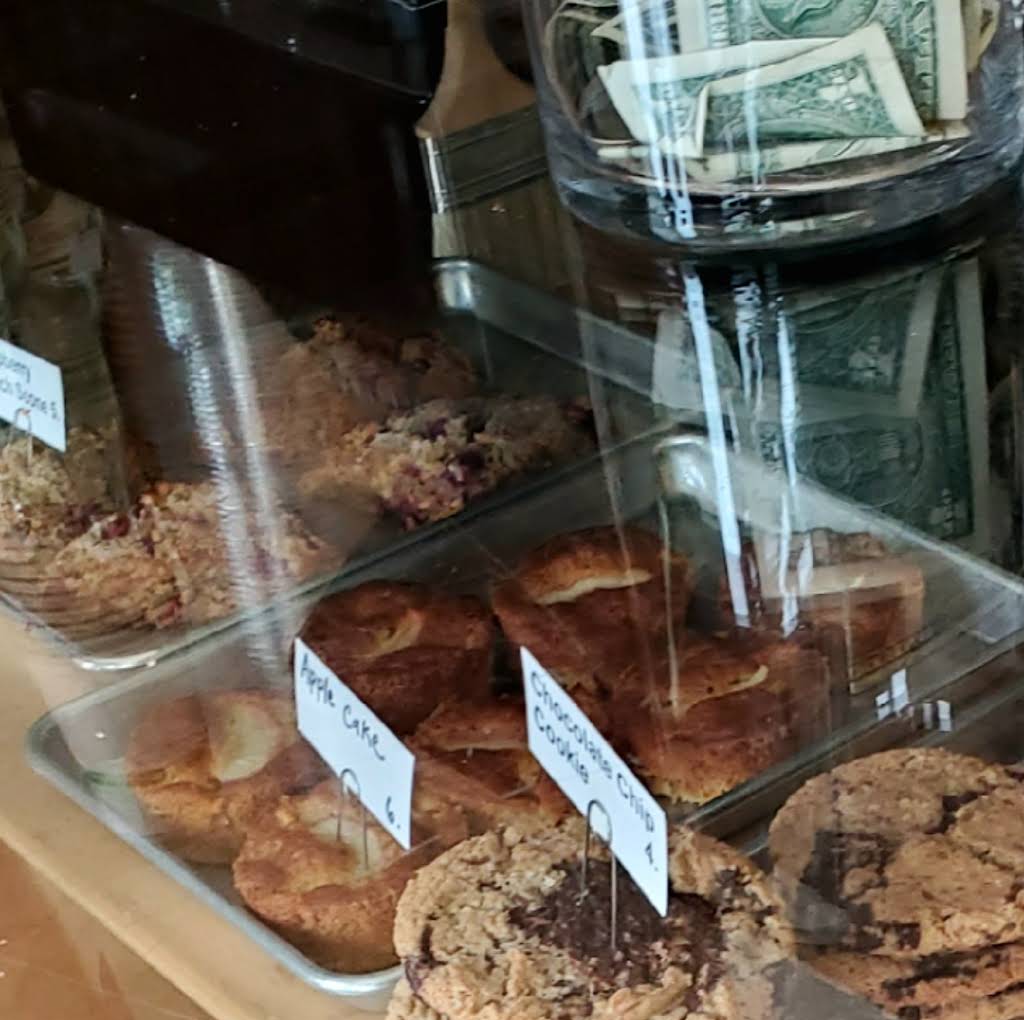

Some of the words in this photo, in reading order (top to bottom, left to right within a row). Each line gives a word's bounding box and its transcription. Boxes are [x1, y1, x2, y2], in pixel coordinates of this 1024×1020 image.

[301, 652, 335, 708] Apple
[342, 705, 385, 761] Cake
[531, 671, 613, 780] Chocolate
[616, 771, 655, 833] Chip
[534, 706, 589, 785] Cookie
